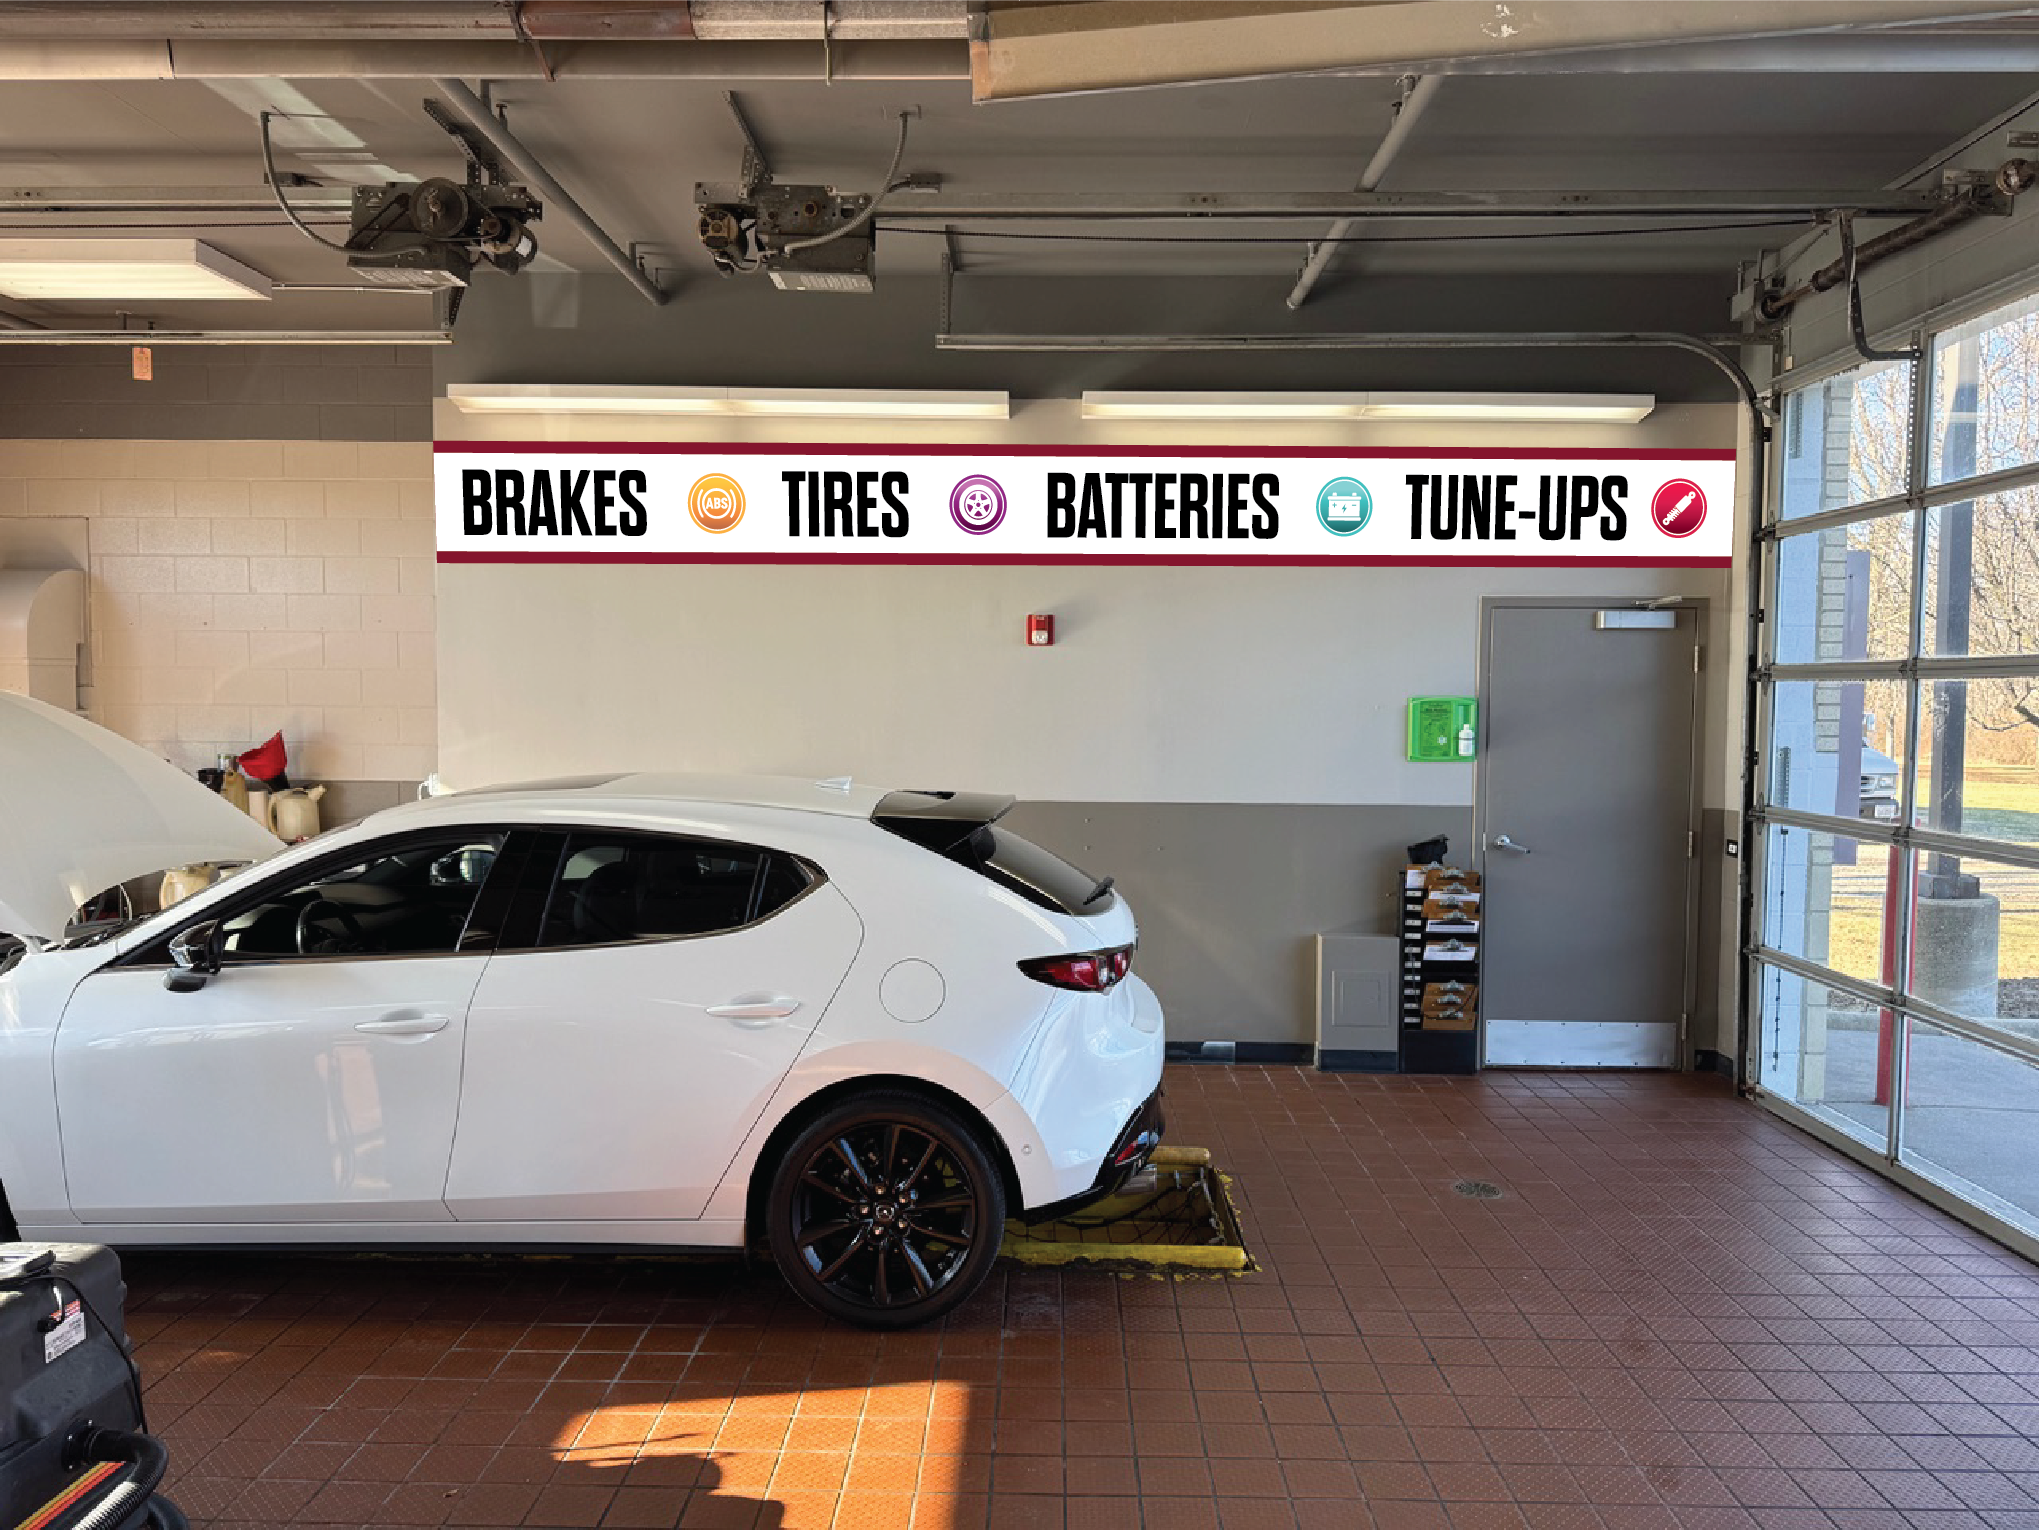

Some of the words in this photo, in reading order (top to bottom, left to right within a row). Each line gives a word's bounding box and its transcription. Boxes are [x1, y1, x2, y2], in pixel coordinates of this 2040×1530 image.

[462, 470, 647, 536] BRAKES
[782, 471, 909, 537] TIRES
[1048, 473, 1279, 539] BATTERIES
[1406, 475, 1628, 540] TUNE-UPS
[706, 497, 728, 509] ABS
